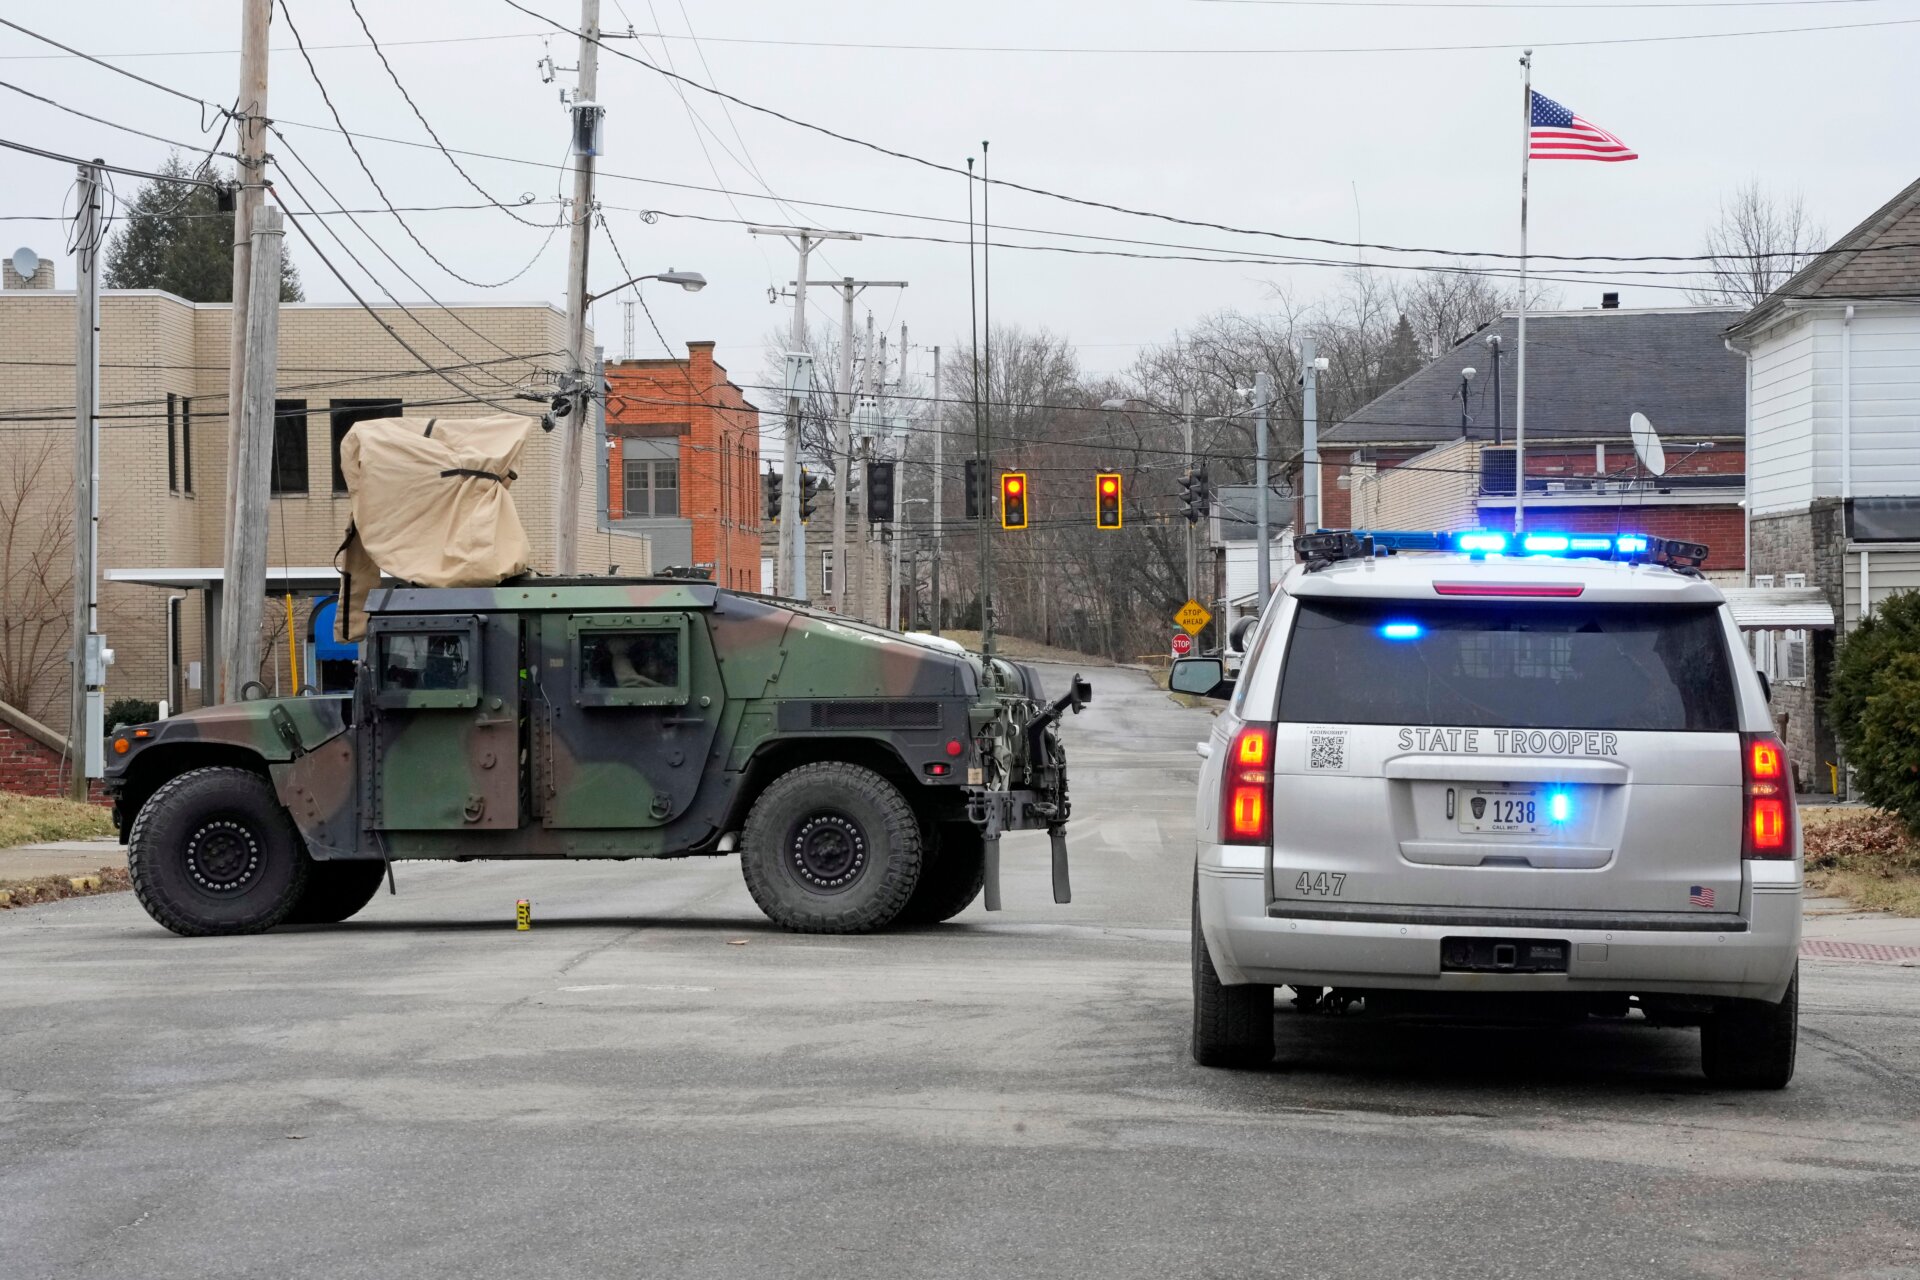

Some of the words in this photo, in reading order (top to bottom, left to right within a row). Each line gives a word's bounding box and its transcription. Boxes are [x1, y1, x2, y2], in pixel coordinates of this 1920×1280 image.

[1173, 640, 1190, 648] STOP
[1398, 728, 1479, 753] STATE
[1494, 730, 1618, 756] TROOPER
[1493, 800, 1536, 824] 1238
[1295, 871, 1347, 896] 447
